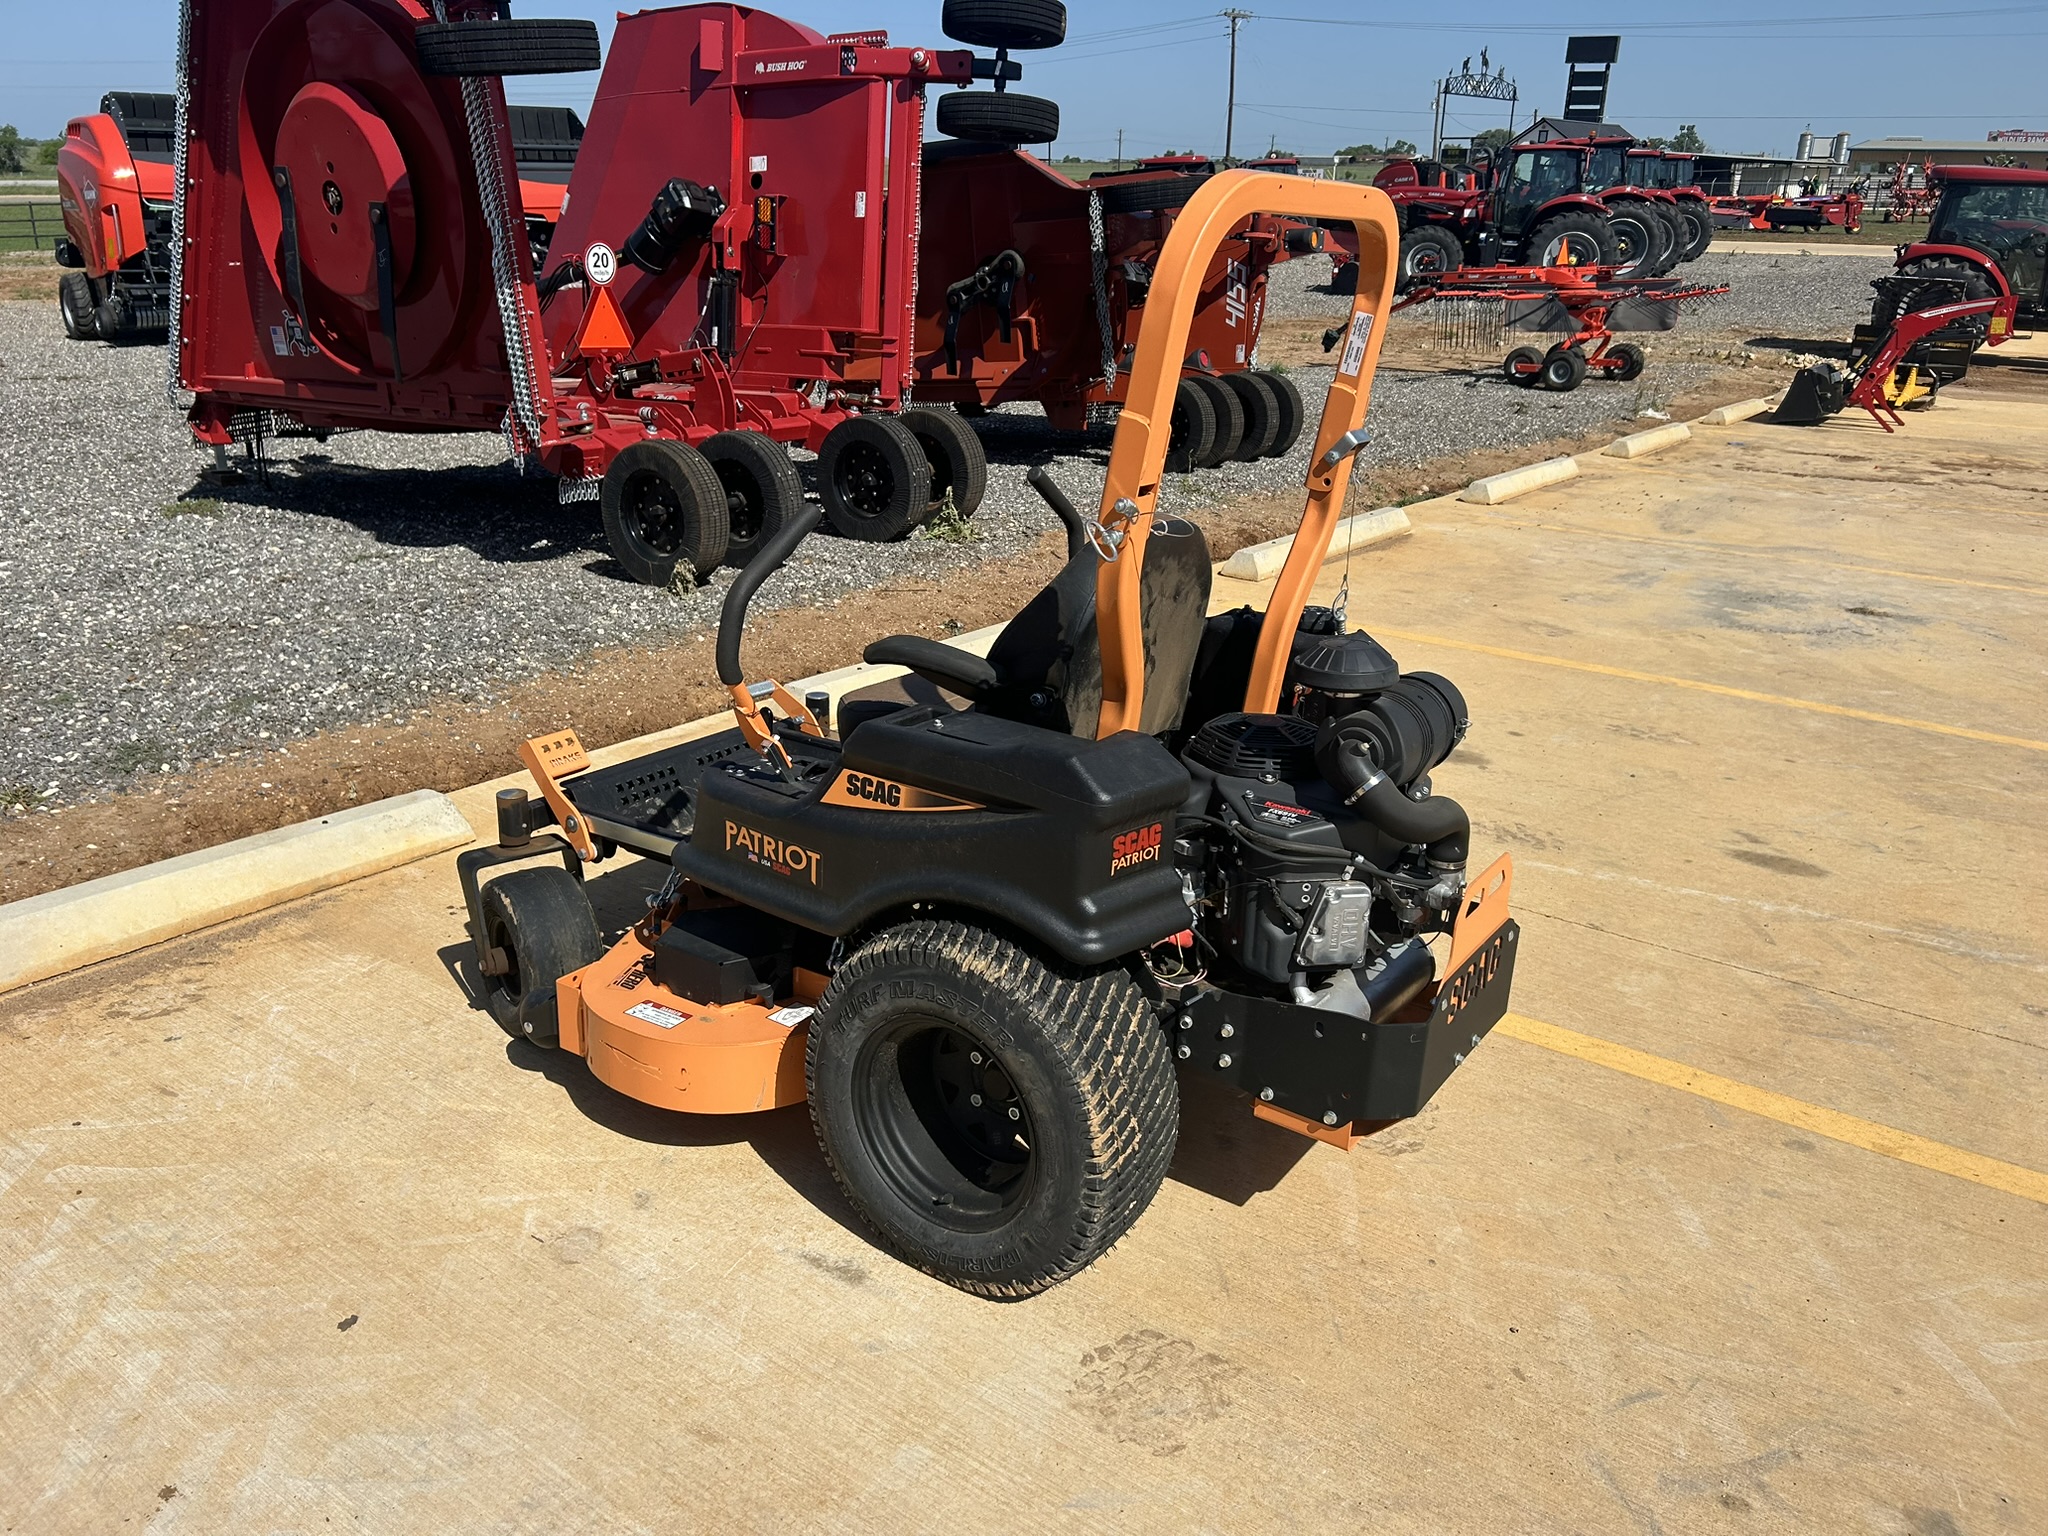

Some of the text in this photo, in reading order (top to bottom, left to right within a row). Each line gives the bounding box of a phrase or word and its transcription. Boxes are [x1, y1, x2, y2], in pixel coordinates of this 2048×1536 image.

[766, 61, 805, 72] BUSH HOG
[592, 252, 609, 268] 20
[846, 773, 901, 807] SCAG
[1264, 801, 1312, 816] Kawasaki
[725, 820, 821, 886] PATRIOT
[1112, 823, 1162, 858] SCAG
[772, 862, 792, 876] SCAG
[1110, 844, 1161, 877] PATRIOT
[1340, 908, 1359, 949] OHV
[1446, 936, 1503, 1025] SCAG
[831, 979, 1015, 1050] TURF MASTER
[884, 1218, 1022, 1273] CARLISLE
